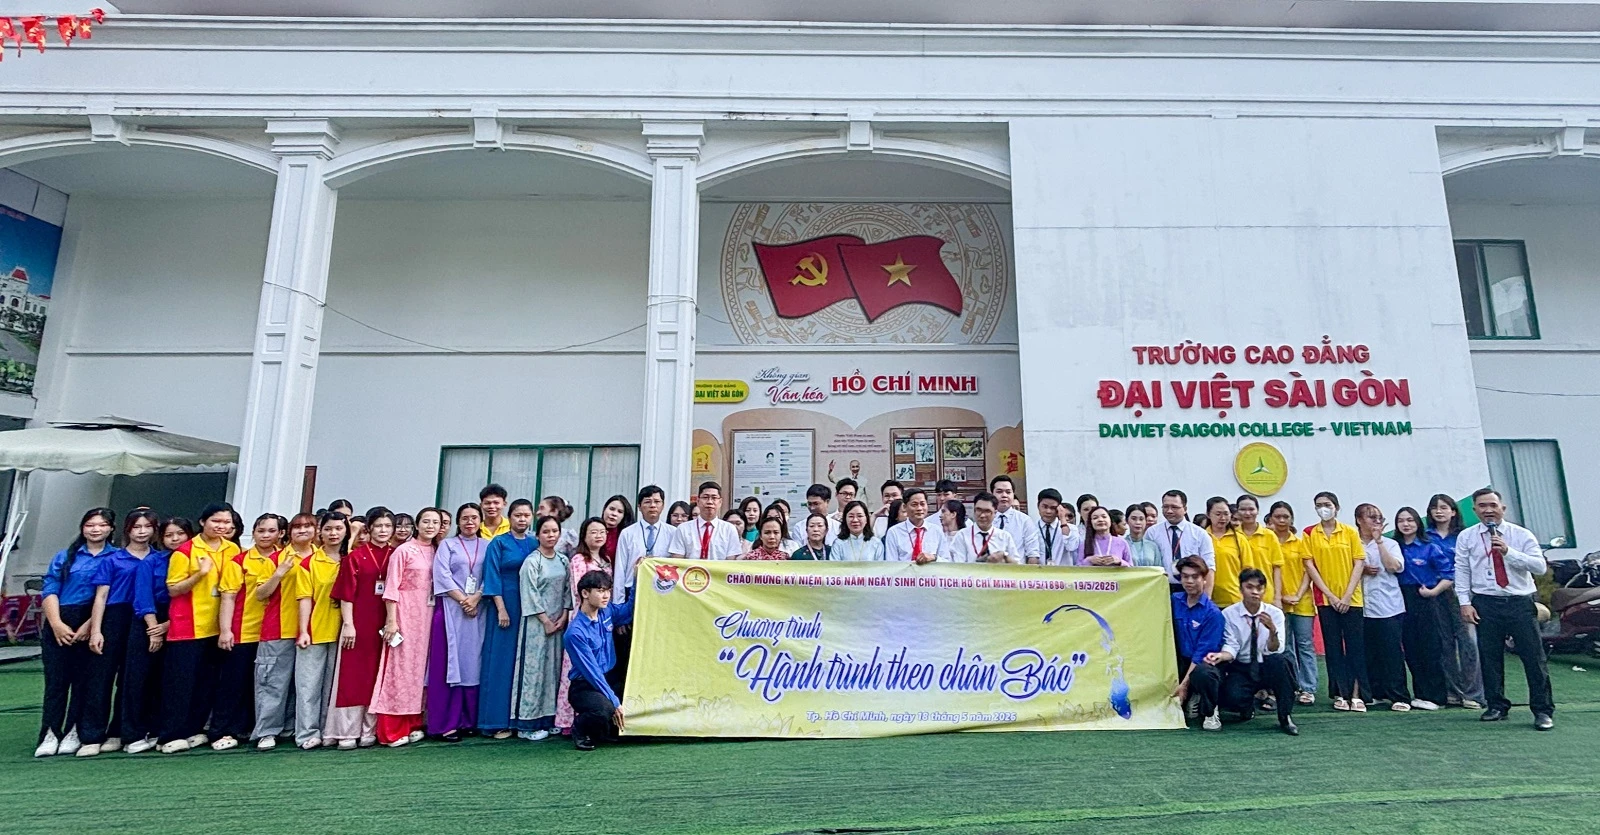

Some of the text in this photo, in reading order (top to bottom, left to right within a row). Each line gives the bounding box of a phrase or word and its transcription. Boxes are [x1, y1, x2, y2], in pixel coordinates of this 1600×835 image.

[1132, 335, 1370, 365] TRƯỜNG CAO ĐẲNG
[756, 366, 808, 385] Không gian
[831, 368, 978, 393] HỒ CHÍ MINH
[768, 385, 826, 403] Văn hóa
[1097, 369, 1412, 418] ĐẠI VIỆT SÀI GÒN
[1099, 422, 1166, 438] DAIVIET
[1169, 422, 1236, 438] SAIGON
[1238, 421, 1315, 437] COLLEGE
[1330, 420, 1413, 437] VIETNAM
[727, 572, 751, 584] CHÀO
[798, 574, 822, 588] NIỆM
[826, 576, 842, 586] 136
[868, 574, 892, 586] NGÀY
[894, 577, 916, 587] SINH
[939, 578, 958, 590] TỊCH
[975, 577, 991, 588] CHÍ
[993, 579, 1016, 589] MINH
[1074, 581, 1118, 591] 19/5/2026)
[714, 611, 822, 646] Chương trình
[825, 646, 884, 691] trình
[886, 646, 934, 691] theo
[939, 647, 998, 692] chân
[806, 710, 1017, 724] Tp. Hồ Chí Minh, ngày 18 tháng 5 năm 2026
